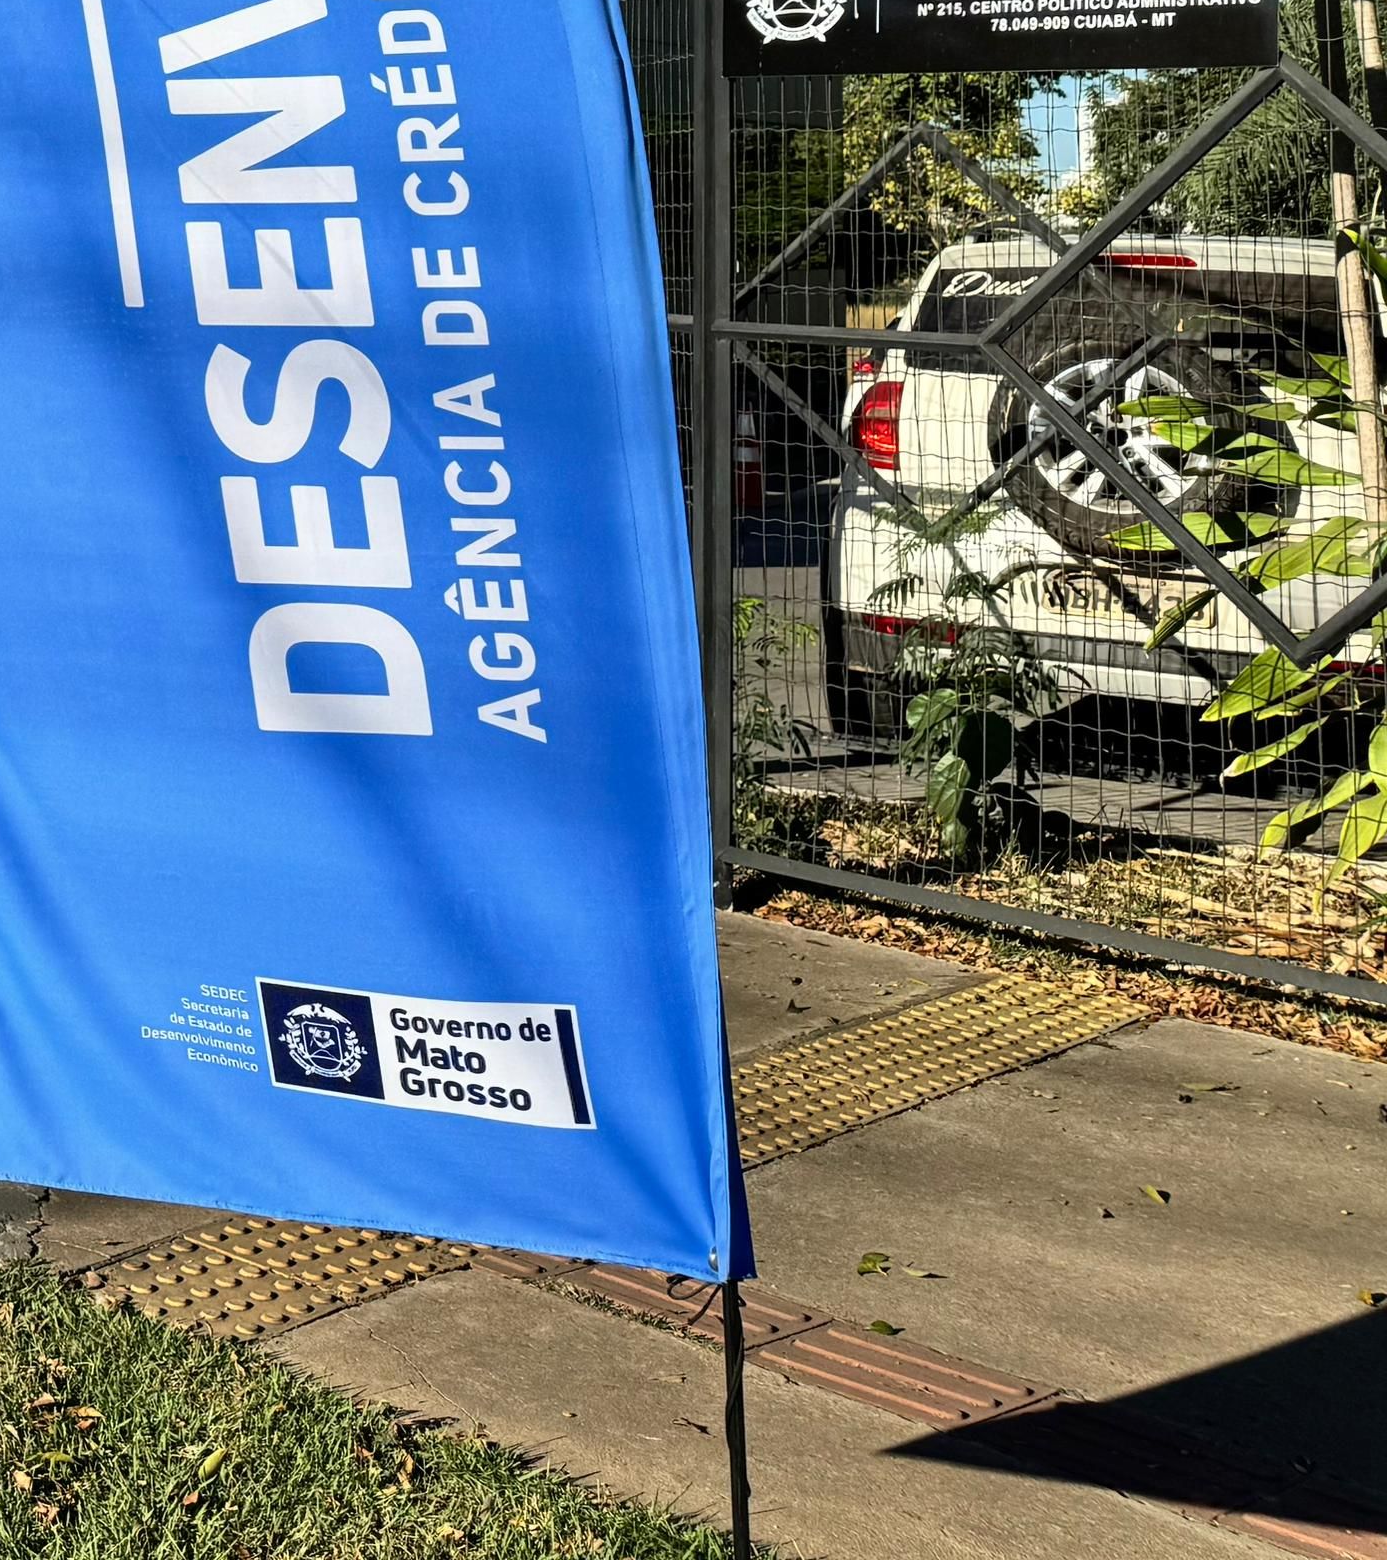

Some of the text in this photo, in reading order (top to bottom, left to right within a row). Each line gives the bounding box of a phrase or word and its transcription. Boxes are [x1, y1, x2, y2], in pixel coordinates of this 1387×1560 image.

[936, 2, 966, 17] 215,
[990, 16, 1070, 32] 78.049-909
[1073, 9, 1138, 29] CUIABÁ
[1151, 12, 1176, 27] MT
[413, 246, 490, 346] DE
[433, 374, 547, 744] AGÊNCIA
[200, 984, 249, 1003] SEDEC
[181, 997, 250, 1020] Secretaria
[170, 1012, 253, 1038] de Estado de
[389, 1007, 552, 1042] Governo de
[141, 1026, 256, 1055] Desenvolvimento
[187, 1047, 259, 1073] Econômico
[395, 1035, 487, 1075] Mato
[399, 1067, 532, 1112] Grosso
